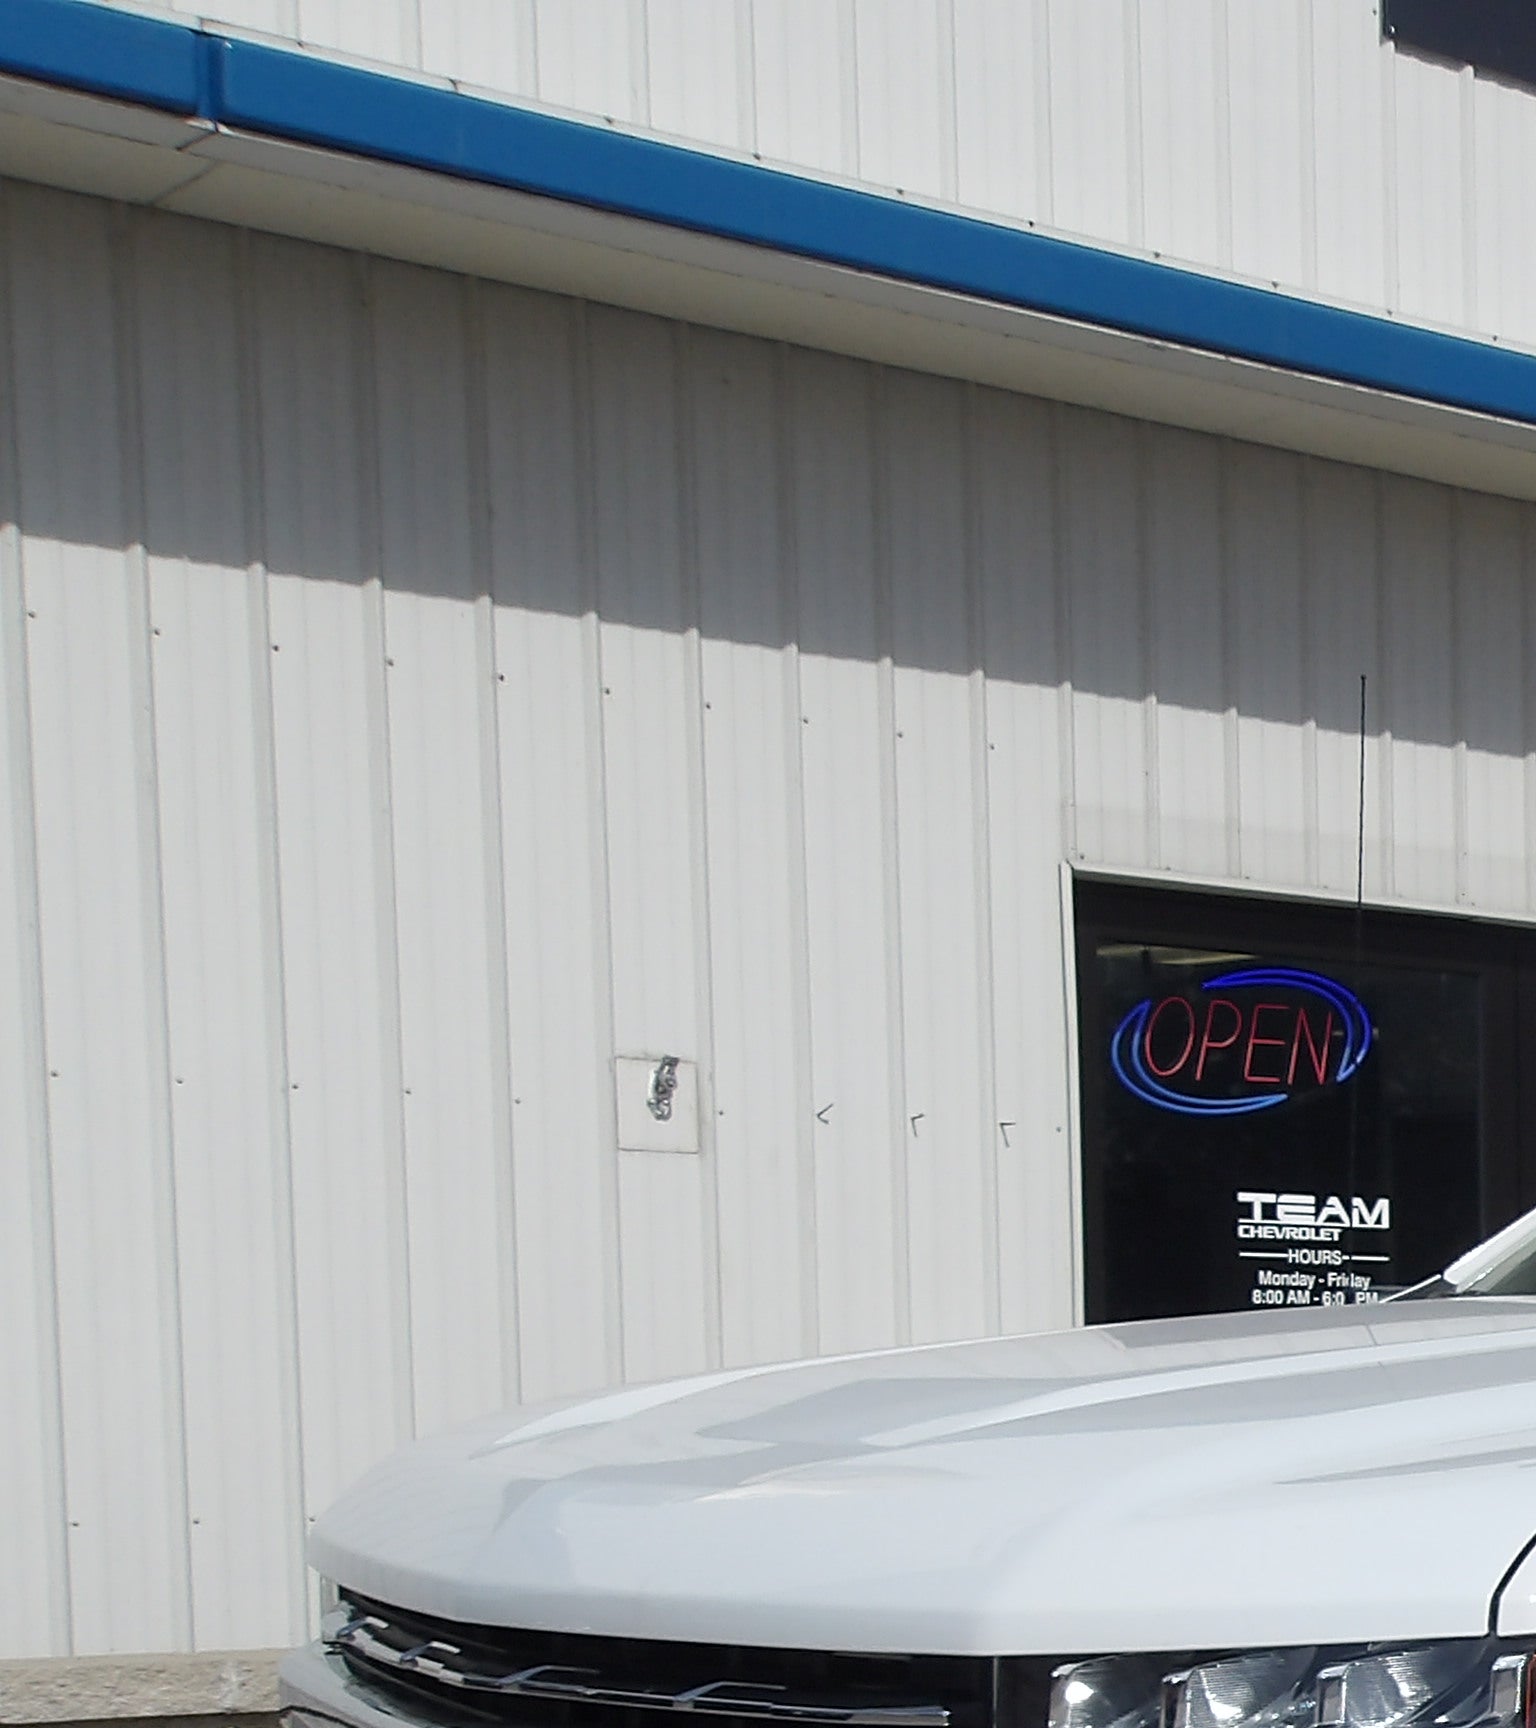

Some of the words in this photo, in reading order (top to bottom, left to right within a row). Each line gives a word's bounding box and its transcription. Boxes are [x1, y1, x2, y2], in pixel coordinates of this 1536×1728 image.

[1144, 996, 1333, 1086] OPEN
[1237, 1191, 1390, 1229] TEAM
[1237, 1224, 1343, 1242] CHEVROLET
[1287, 1249, 1343, 1266] HOURS
[1257, 1269, 1316, 1290] Monday
[1252, 1289, 1284, 1305] 8:00
[1285, 1289, 1311, 1305] AM
[1321, 1290, 1352, 1306] 6:0
[1354, 1292, 1379, 1304] PM
